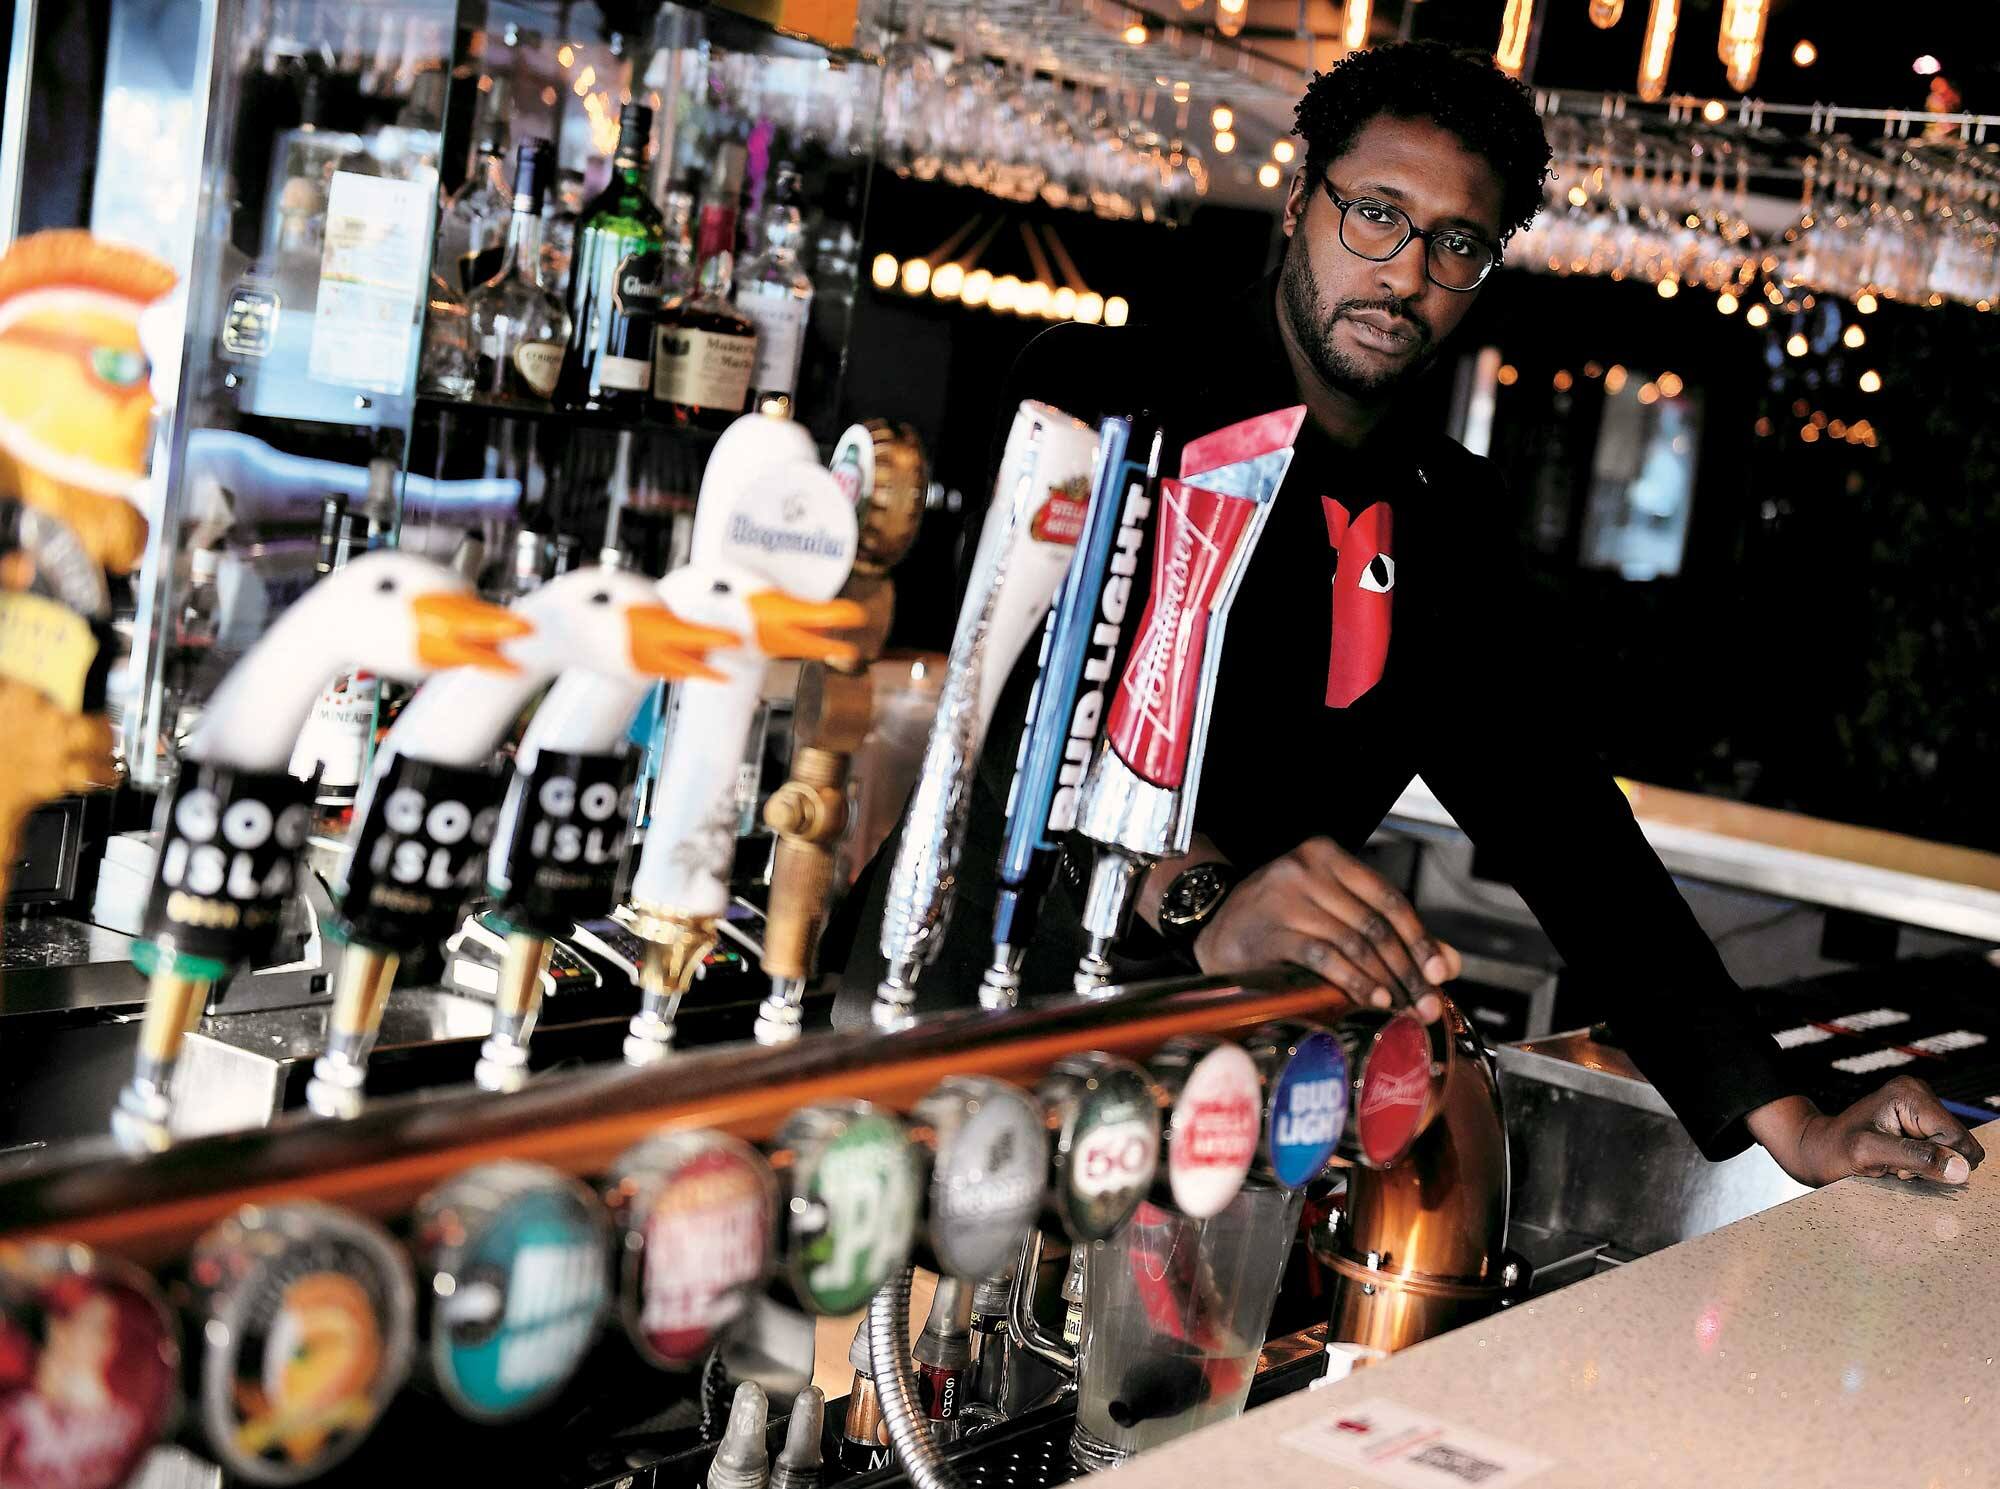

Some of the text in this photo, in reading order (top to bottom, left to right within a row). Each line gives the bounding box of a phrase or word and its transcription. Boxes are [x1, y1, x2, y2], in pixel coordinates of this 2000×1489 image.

[1047, 482, 1151, 832] BUD LIGHT
[1290, 1078, 1343, 1115] BUD
[1086, 1136, 1147, 1181] 50
[941, 1377, 955, 1418] SOHO
